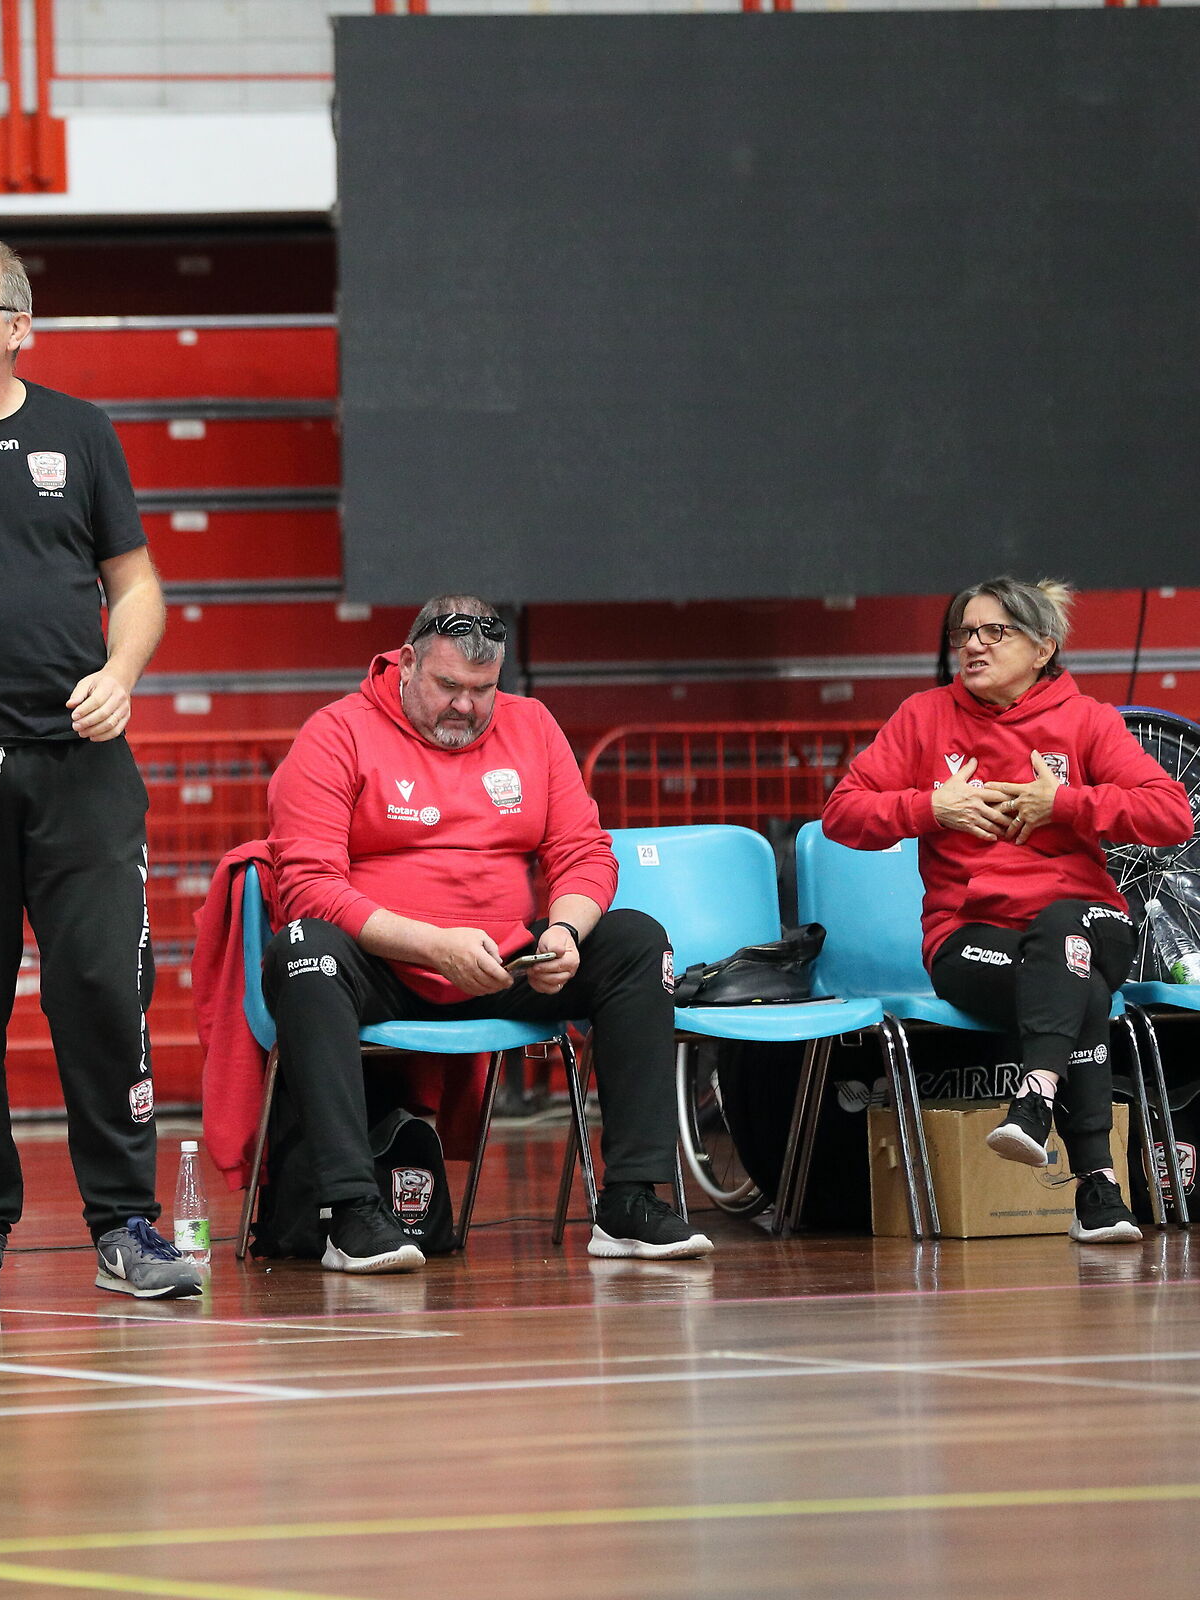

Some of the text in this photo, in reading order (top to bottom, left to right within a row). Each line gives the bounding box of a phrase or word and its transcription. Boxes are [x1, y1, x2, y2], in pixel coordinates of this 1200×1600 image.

[387, 804, 419, 817] Rotary
[641, 847, 653, 858] 29
[961, 944, 1013, 966] RUGBY
[287, 957, 319, 971] Rotary
